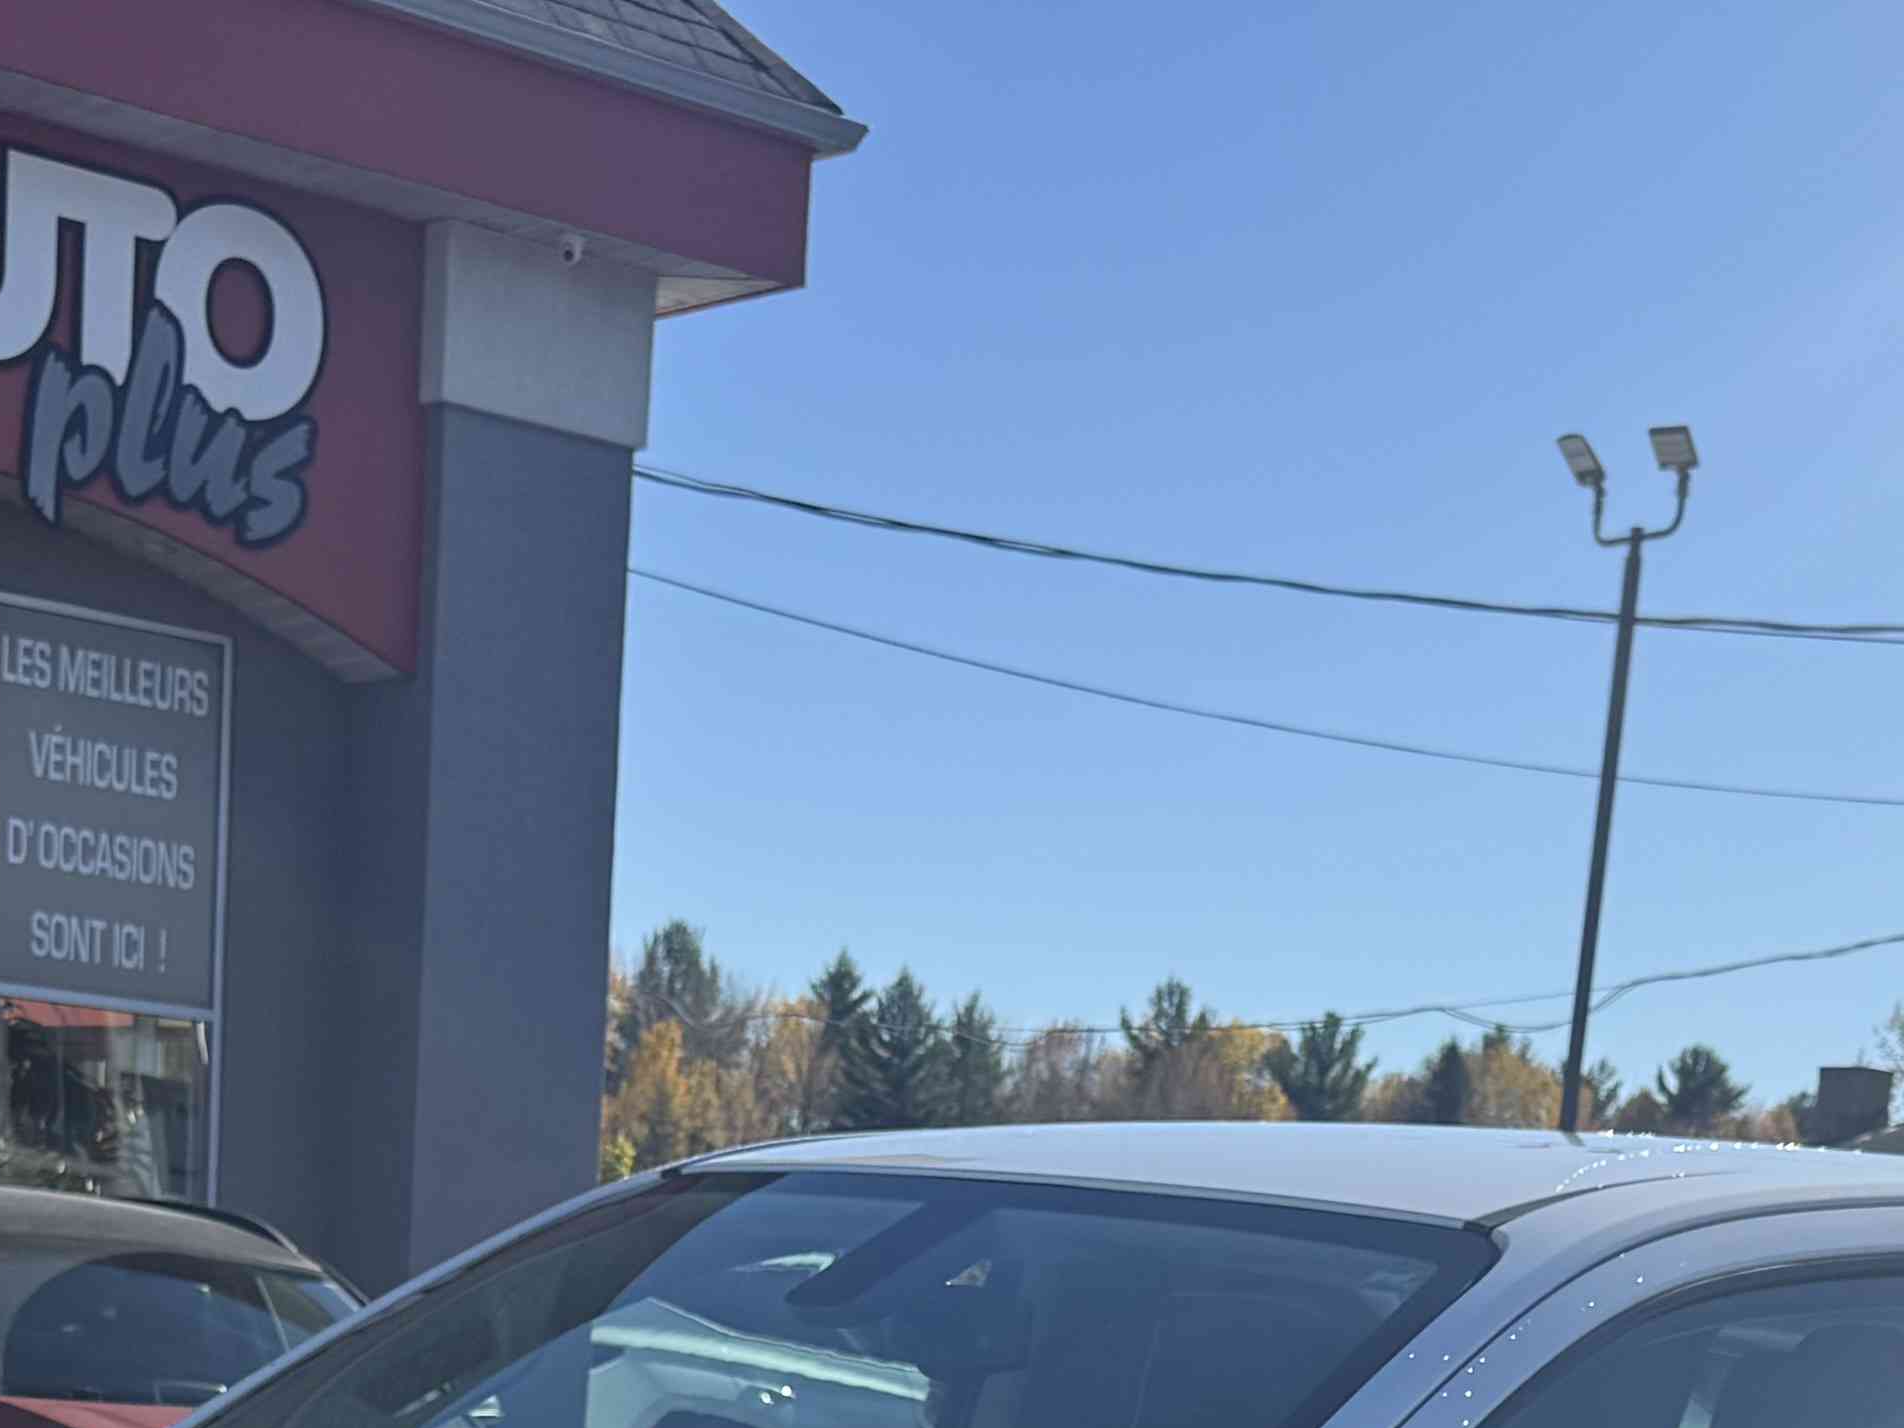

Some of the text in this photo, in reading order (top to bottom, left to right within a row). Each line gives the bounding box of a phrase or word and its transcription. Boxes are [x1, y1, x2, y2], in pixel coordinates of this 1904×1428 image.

[24, 300, 314, 544] plus
[1, 634, 210, 717] LES MEILLEURS
[28, 723, 178, 800] VÉHICULES
[30, 908, 107, 966] SONT
[112, 920, 146, 973] ICI
